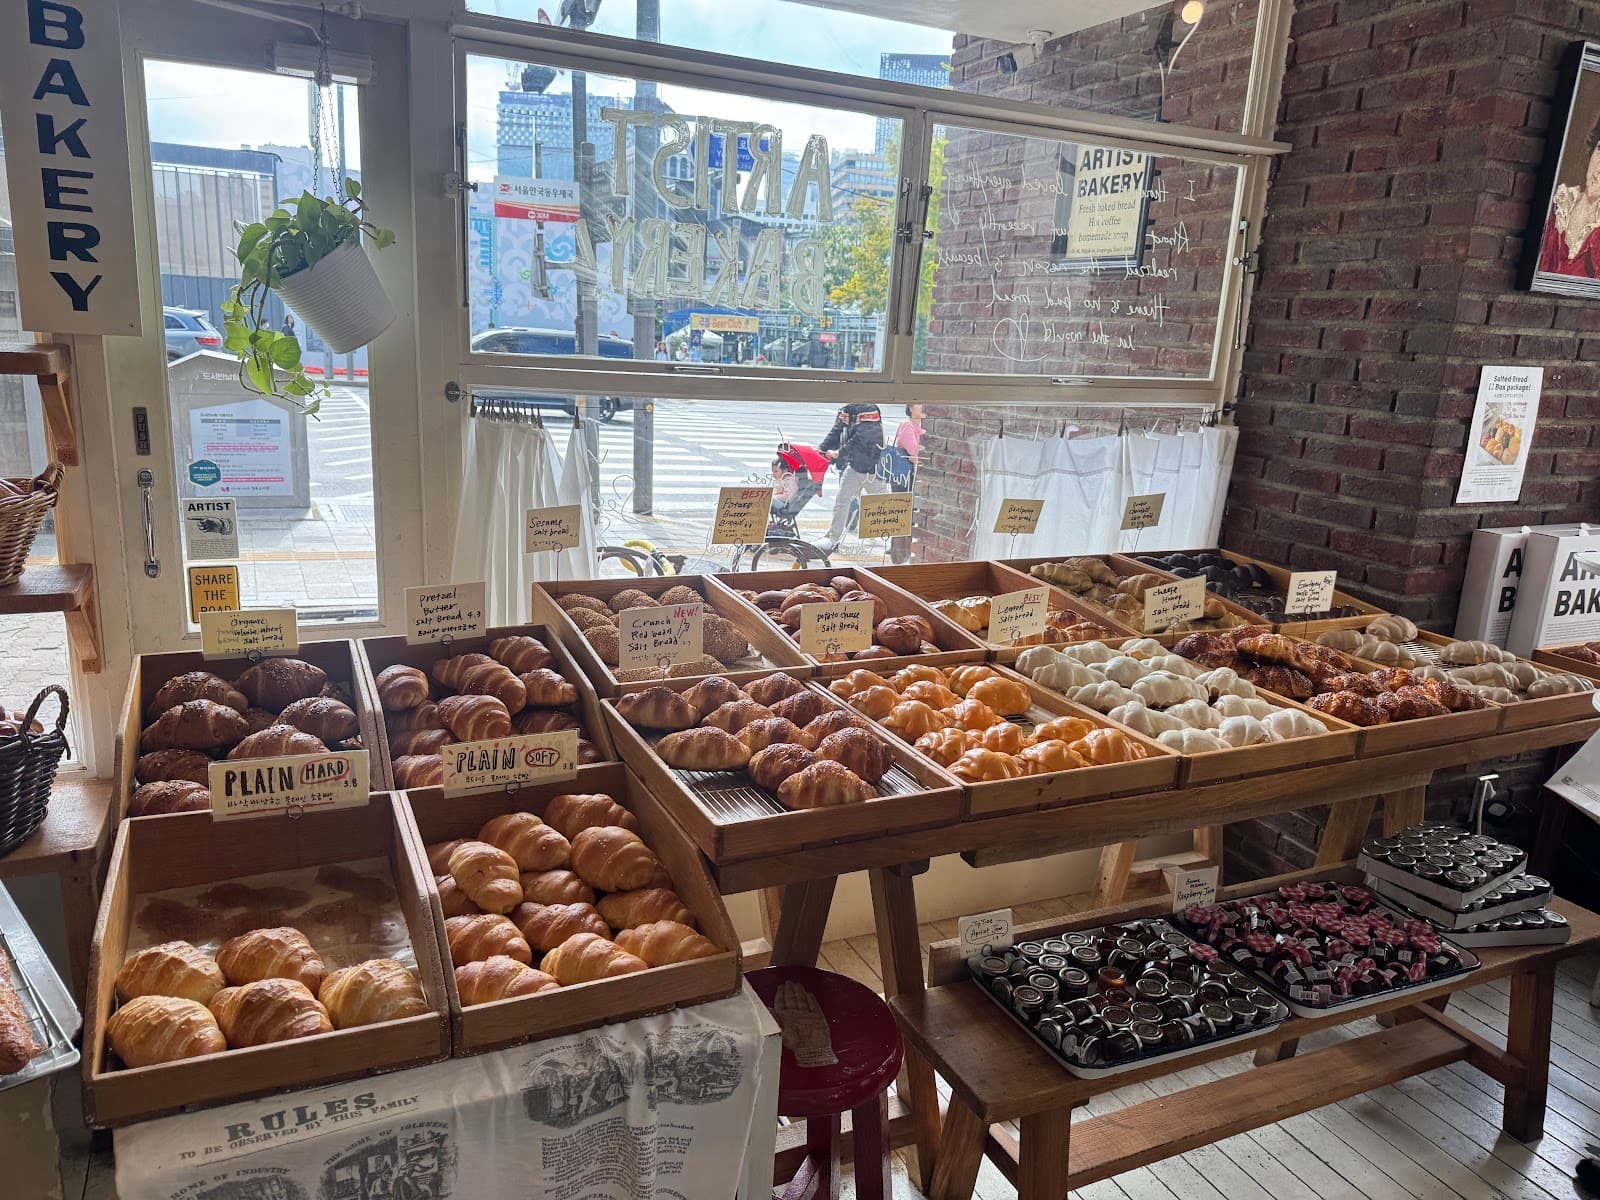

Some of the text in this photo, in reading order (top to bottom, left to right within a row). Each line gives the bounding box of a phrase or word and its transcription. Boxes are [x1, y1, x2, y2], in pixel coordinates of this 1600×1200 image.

[27, 0, 102, 311] BAKERY
[1078, 171, 1144, 198] BAKERY
[1079, 202, 1096, 214] Fresh
[1117, 200, 1136, 210] bread
[1494, 375, 1512, 383] Salted
[1495, 383, 1505, 391] Box
[1506, 383, 1532, 392] package!
[187, 502, 231, 512] ARTIST
[195, 573, 233, 586] SHARE
[204, 590, 227, 601] THE
[673, 606, 699, 618] NEW!
[633, 615, 671, 628] Crunch
[631, 630, 648, 641] Red
[457, 748, 516, 773] PLAIN
[528, 750, 556, 766] SOFT
[225, 766, 294, 797] PLAIN
[305, 760, 344, 781] HARD
[224, 1092, 377, 1143] RULES
[178, 1095, 419, 1161] TO BE OBSERVED BY THIS FAMILY
[213, 1172, 229, 1182] OF
